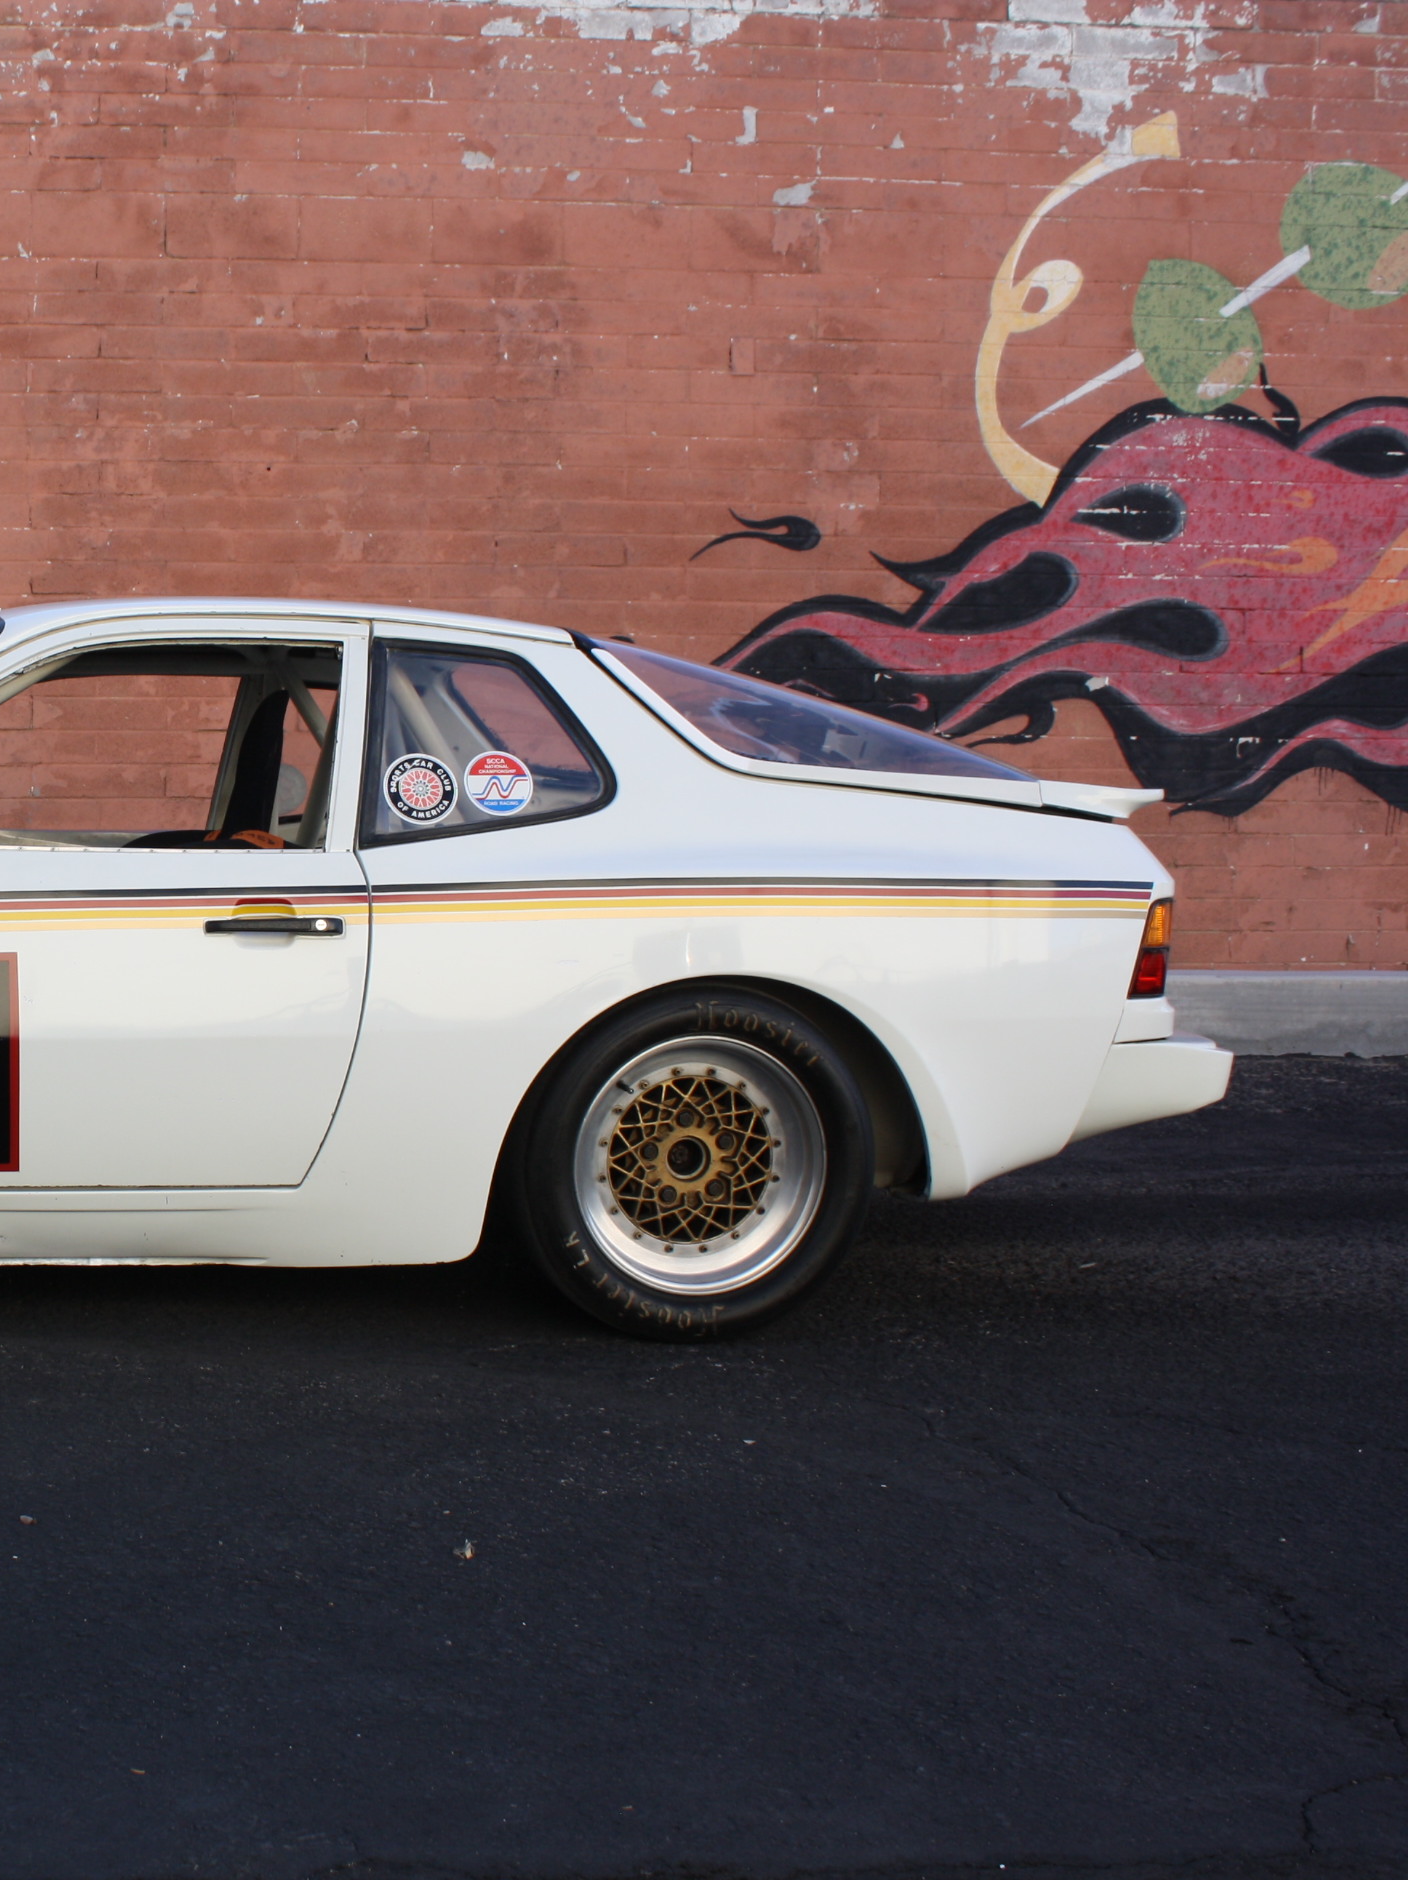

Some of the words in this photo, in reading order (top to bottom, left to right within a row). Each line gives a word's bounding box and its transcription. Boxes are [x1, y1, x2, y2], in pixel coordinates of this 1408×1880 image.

[390, 762, 411, 793] SPORTS
[412, 760, 434, 769] CAR
[436, 768, 452, 792] CLUB
[397, 801, 410, 812] OF
[411, 800, 449, 819] AMERICA
[692, 1001, 827, 1067] Hoosier
